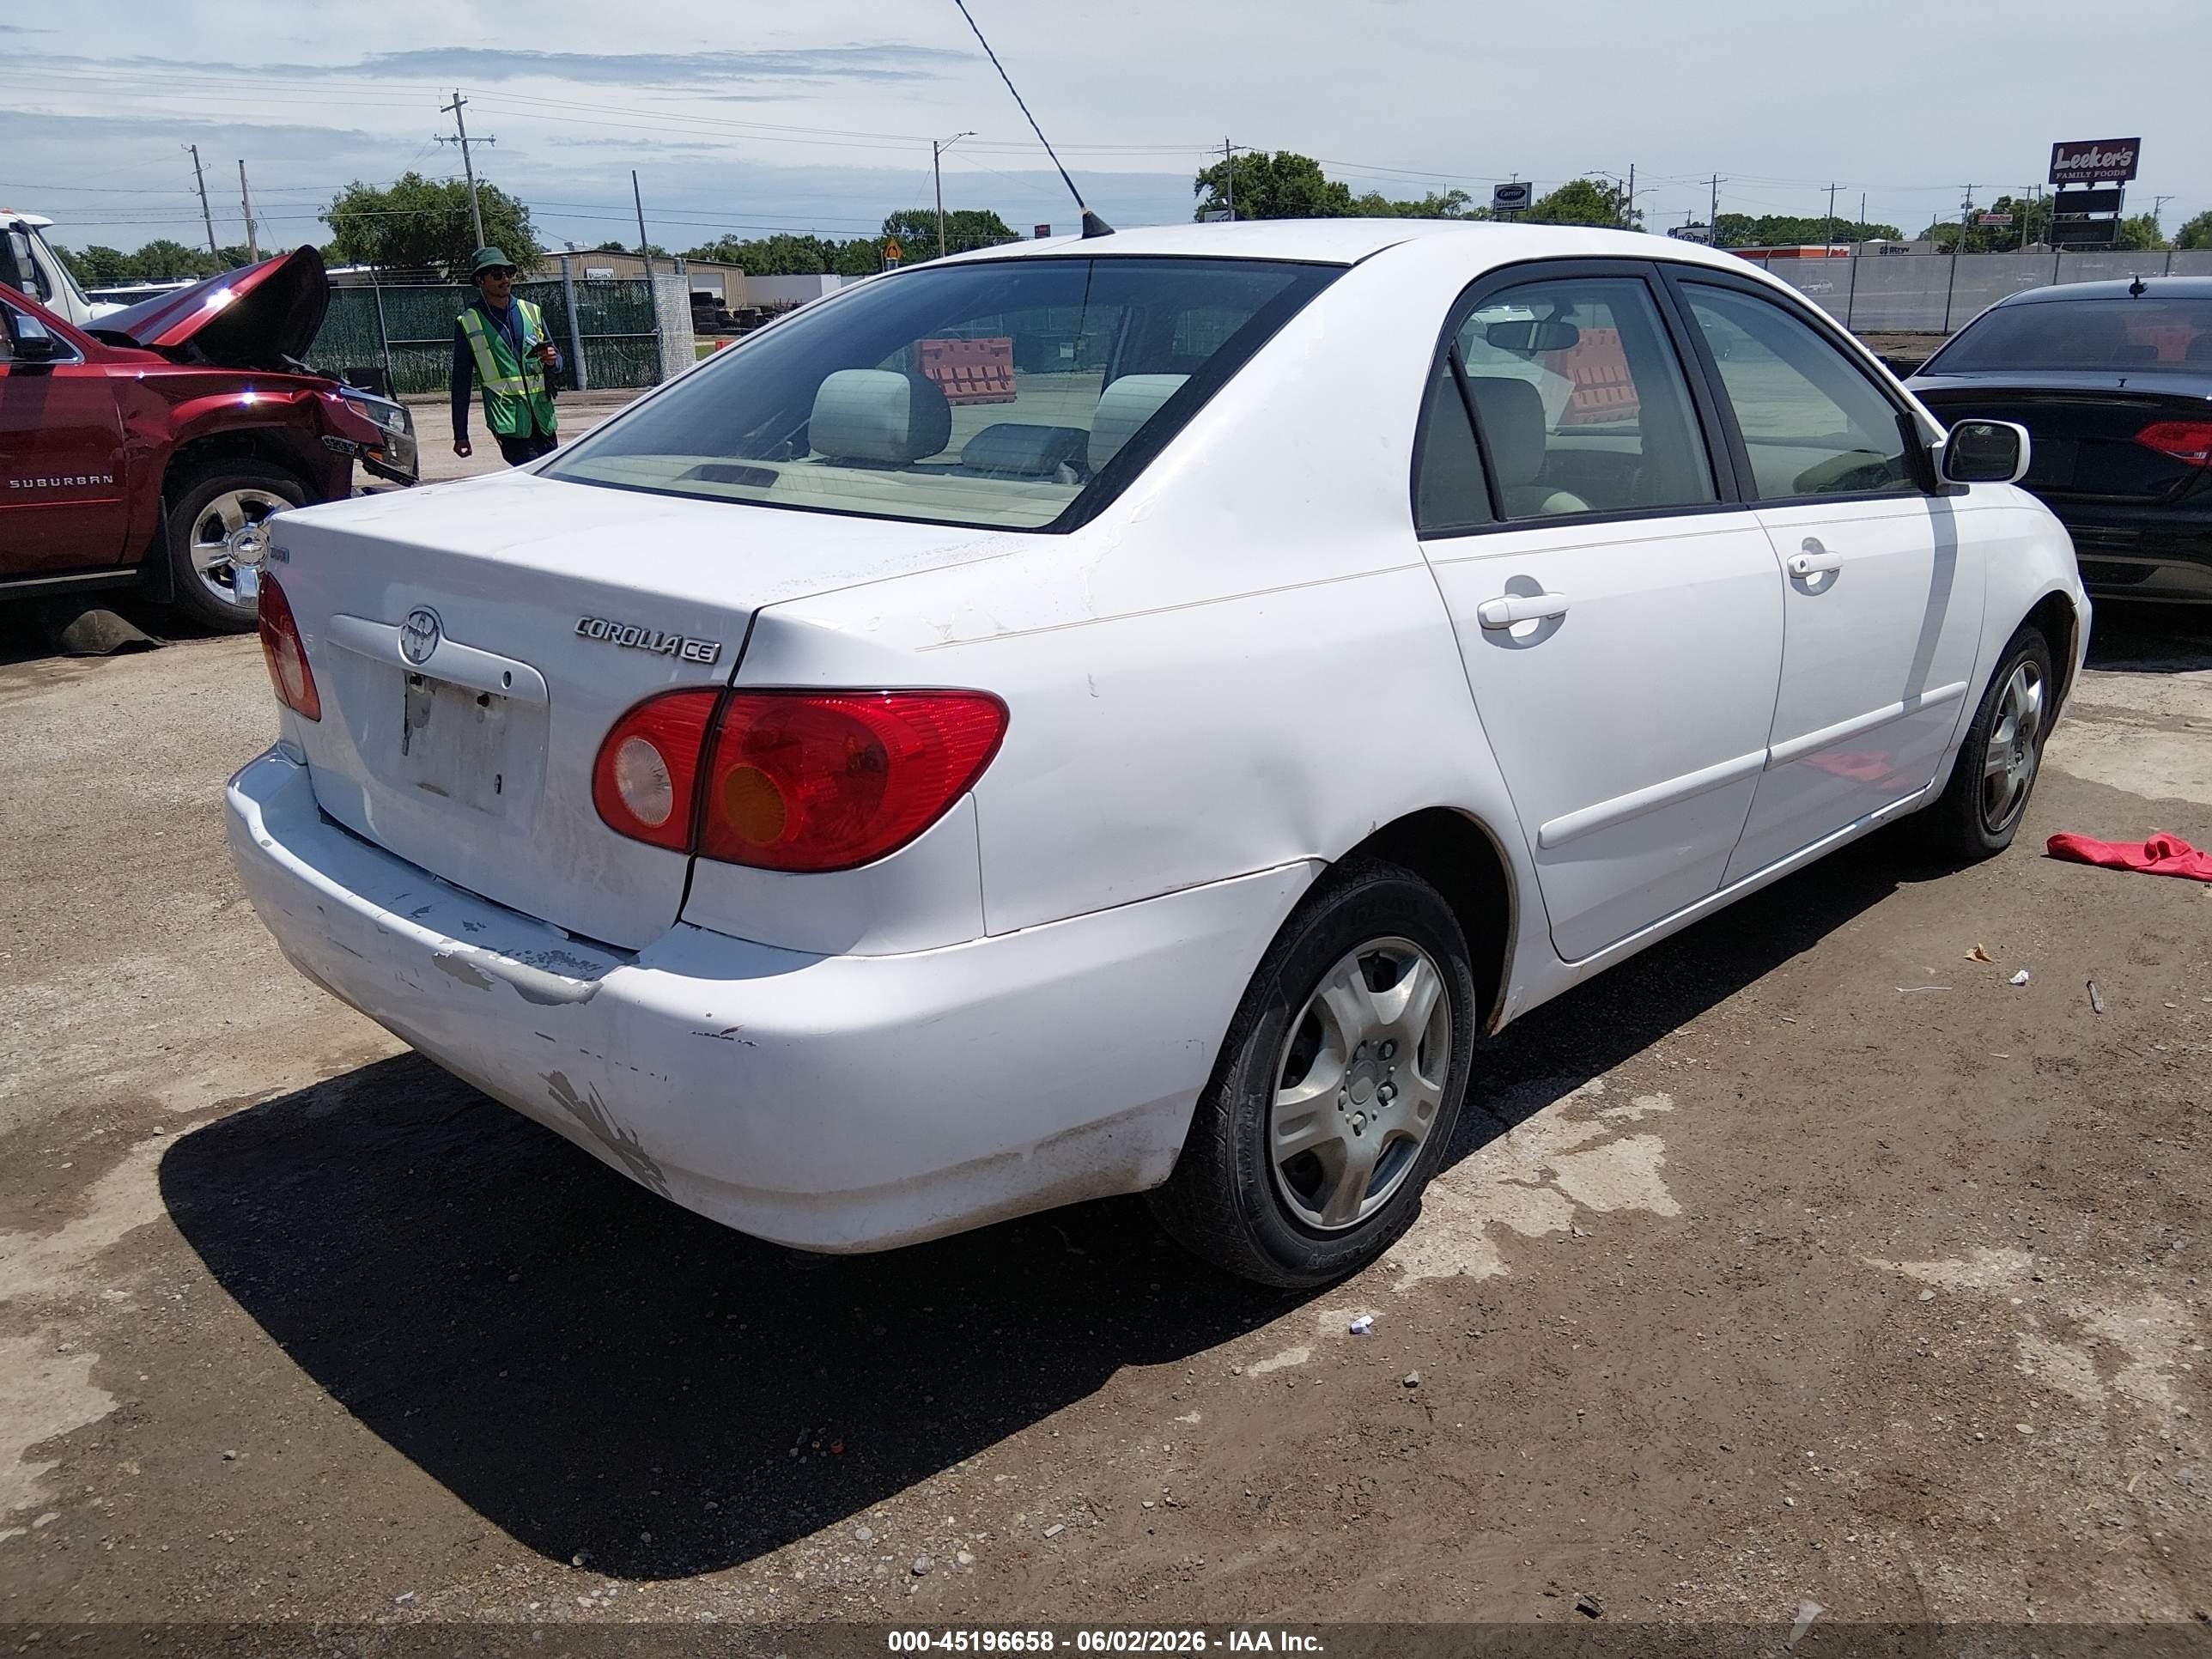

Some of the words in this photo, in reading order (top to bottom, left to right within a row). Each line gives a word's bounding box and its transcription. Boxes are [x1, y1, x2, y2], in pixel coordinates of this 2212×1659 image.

[2053, 146, 2134, 170] Leeker's
[2055, 171, 2092, 179] FAMILY
[9, 475, 113, 489] SUBURBAN
[574, 615, 683, 656] COROLLA
[683, 641, 717, 662] CE
